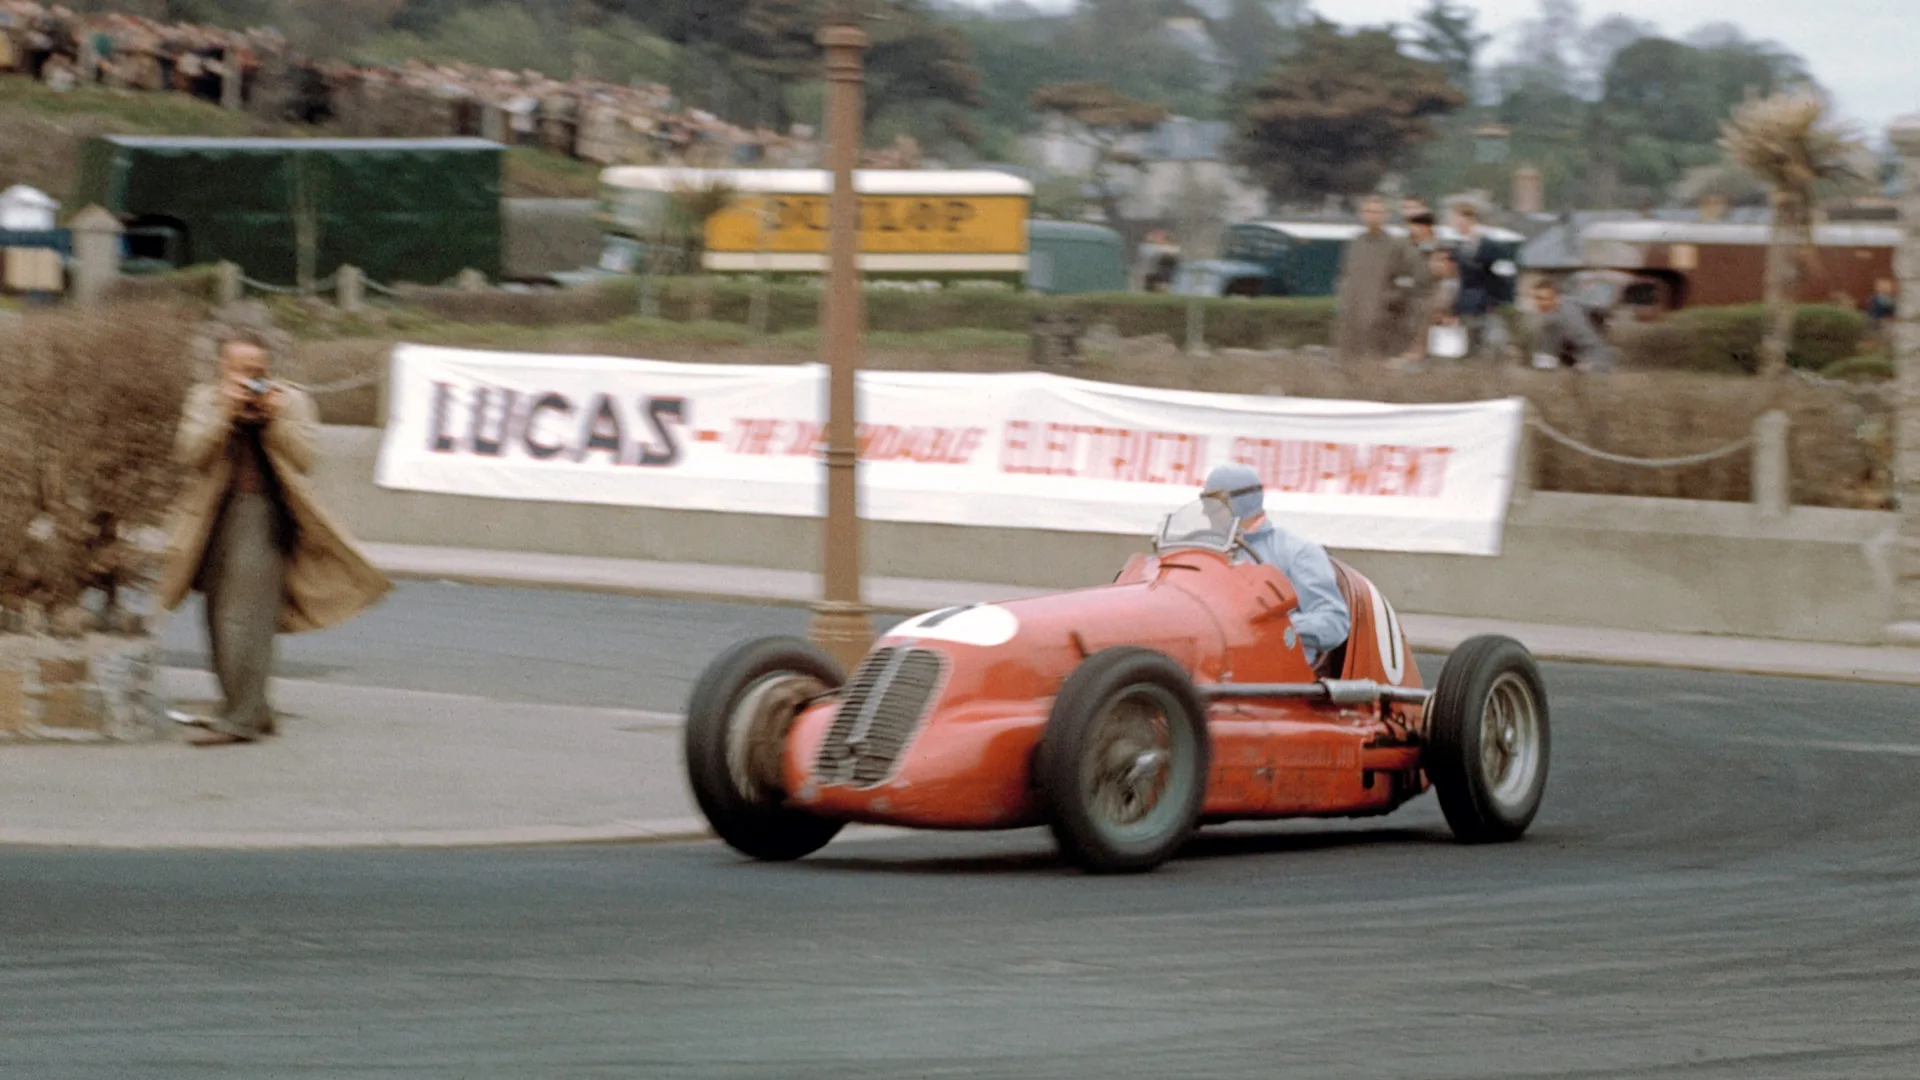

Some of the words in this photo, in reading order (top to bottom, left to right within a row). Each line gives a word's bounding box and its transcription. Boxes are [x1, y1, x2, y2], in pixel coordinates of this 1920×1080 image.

[764, 199, 976, 231] DULOP
[429, 381, 688, 467] LUCAS
[731, 417, 786, 455] THE
[1001, 421, 1208, 487] ELECTRICAL
[1233, 436, 1456, 497] EQUIPMENT
